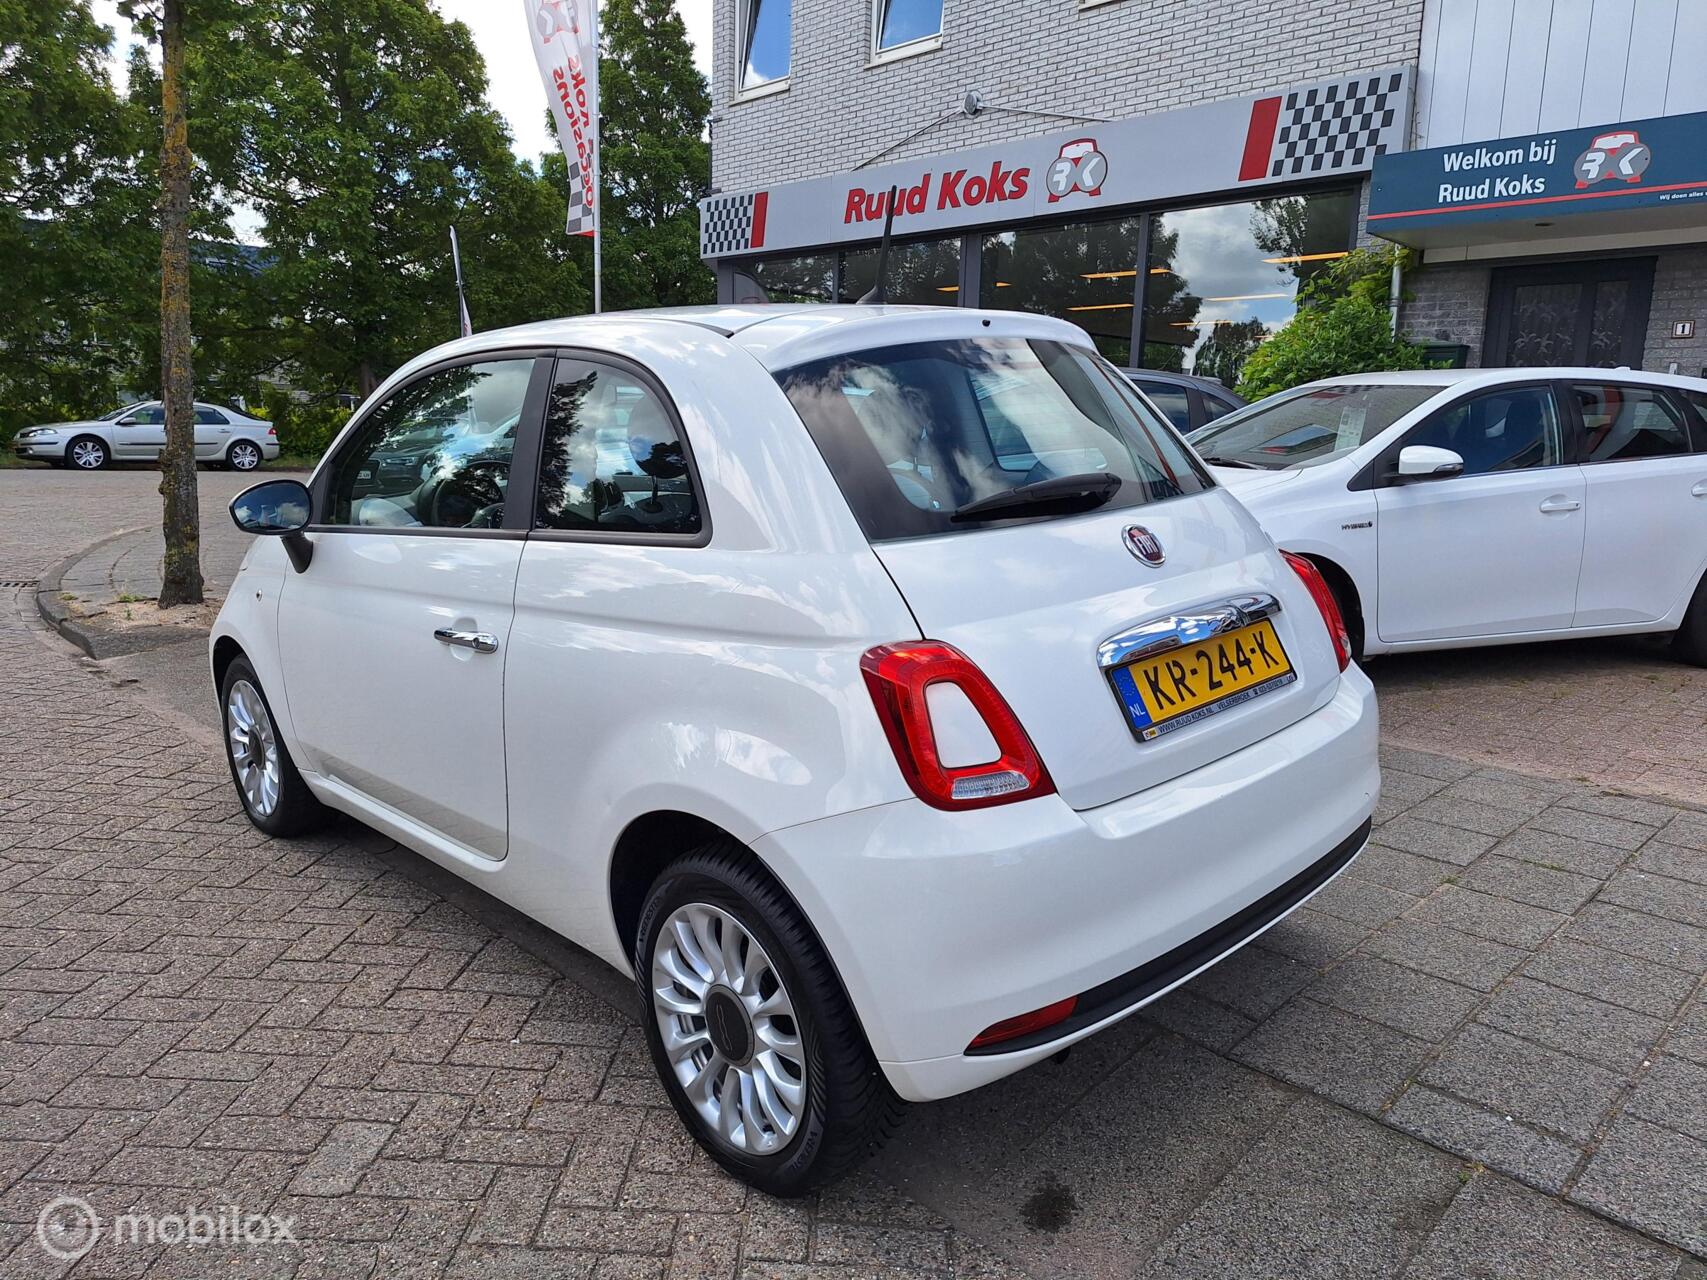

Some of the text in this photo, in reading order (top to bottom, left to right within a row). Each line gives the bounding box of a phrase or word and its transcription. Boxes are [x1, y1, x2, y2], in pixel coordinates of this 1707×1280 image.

[1443, 139, 1557, 172] Welkom bij
[844, 161, 1030, 224] Ruud Koks
[1438, 174, 1546, 203] Ruud Koks
[1681, 324, 1686, 334] 1
[1143, 631, 1279, 710] KR-244-K
[1129, 704, 1146, 718] NL
